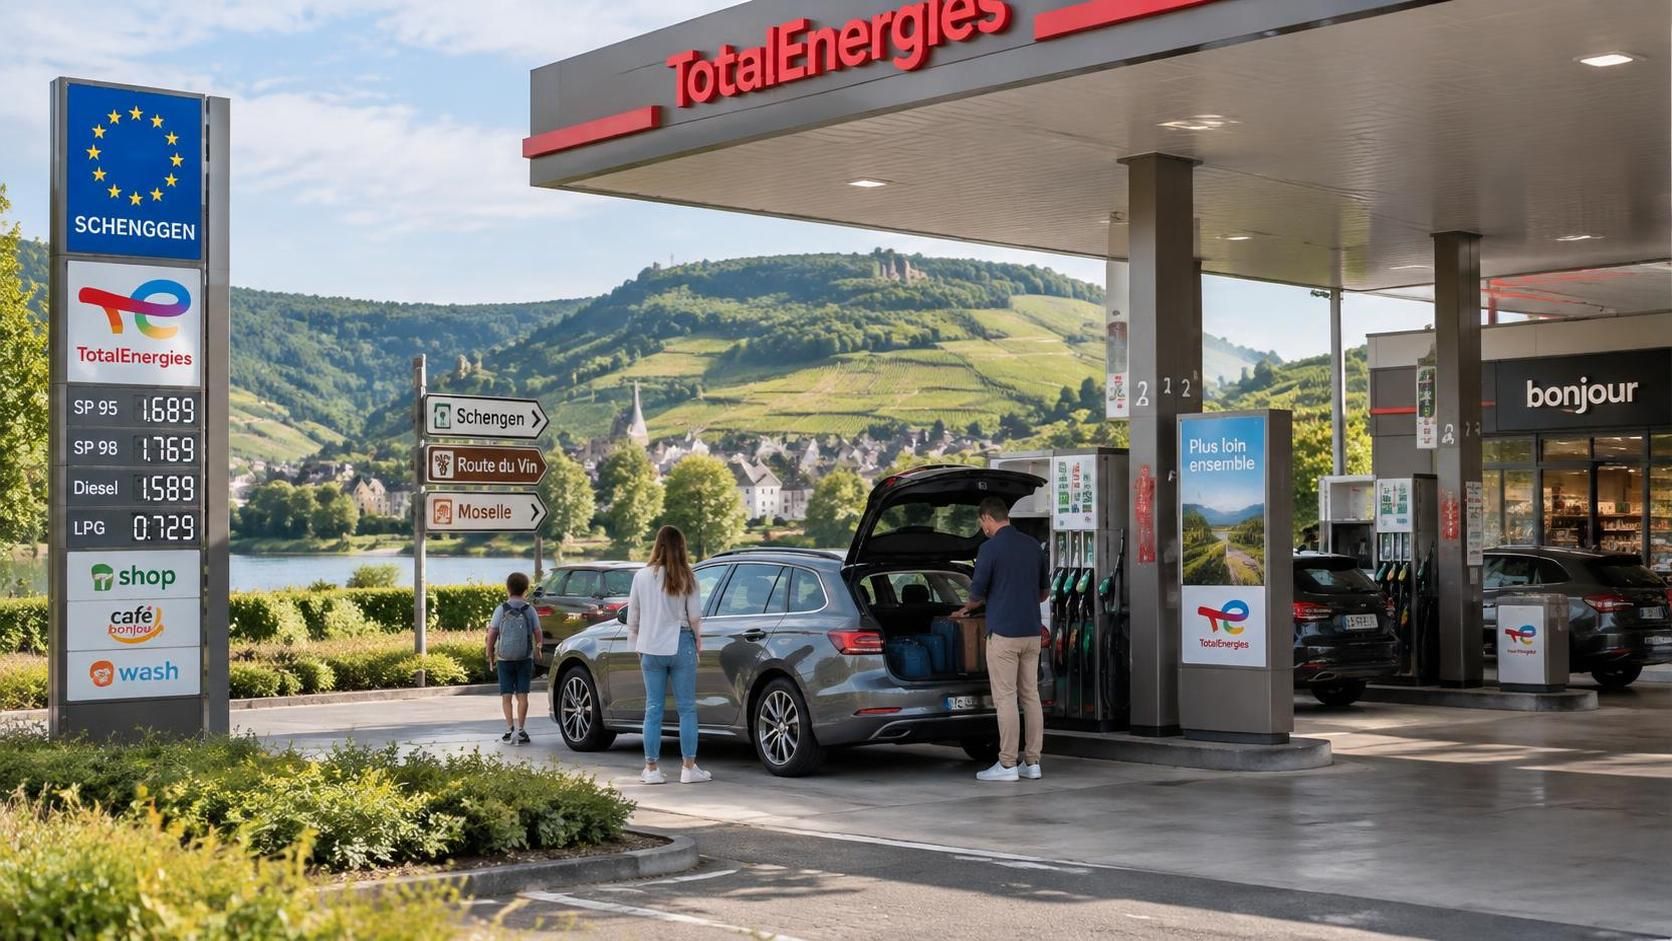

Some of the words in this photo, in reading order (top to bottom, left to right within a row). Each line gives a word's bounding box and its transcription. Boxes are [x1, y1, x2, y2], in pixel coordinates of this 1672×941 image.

[666, 0, 1012, 108] TotalEnergies
[75, 215, 195, 240] SCHENGGEN
[77, 346, 192, 368] TotalEnergies
[1526, 377, 1638, 413] bonjour
[74, 400, 94, 415] SP
[98, 401, 118, 416] 95
[457, 408, 524, 428] Schengen
[74, 440, 94, 455] SP
[98, 441, 118, 455] 98
[1189, 438, 1217, 453] Plus
[1222, 438, 1246, 453] loin
[458, 457, 495, 472] Route
[499, 458, 514, 473] du
[518, 459, 537, 473] Vin
[1189, 456, 1255, 473] ensemble
[74, 480, 118, 495] Diesel
[459, 504, 512, 519] Moselle
[74, 521, 105, 535] LPG
[133, 515, 195, 540] 0.729
[119, 565, 176, 590] shop
[110, 605, 153, 624] café
[1200, 638, 1249, 650] TotalEnergies
[118, 661, 179, 681] wash
